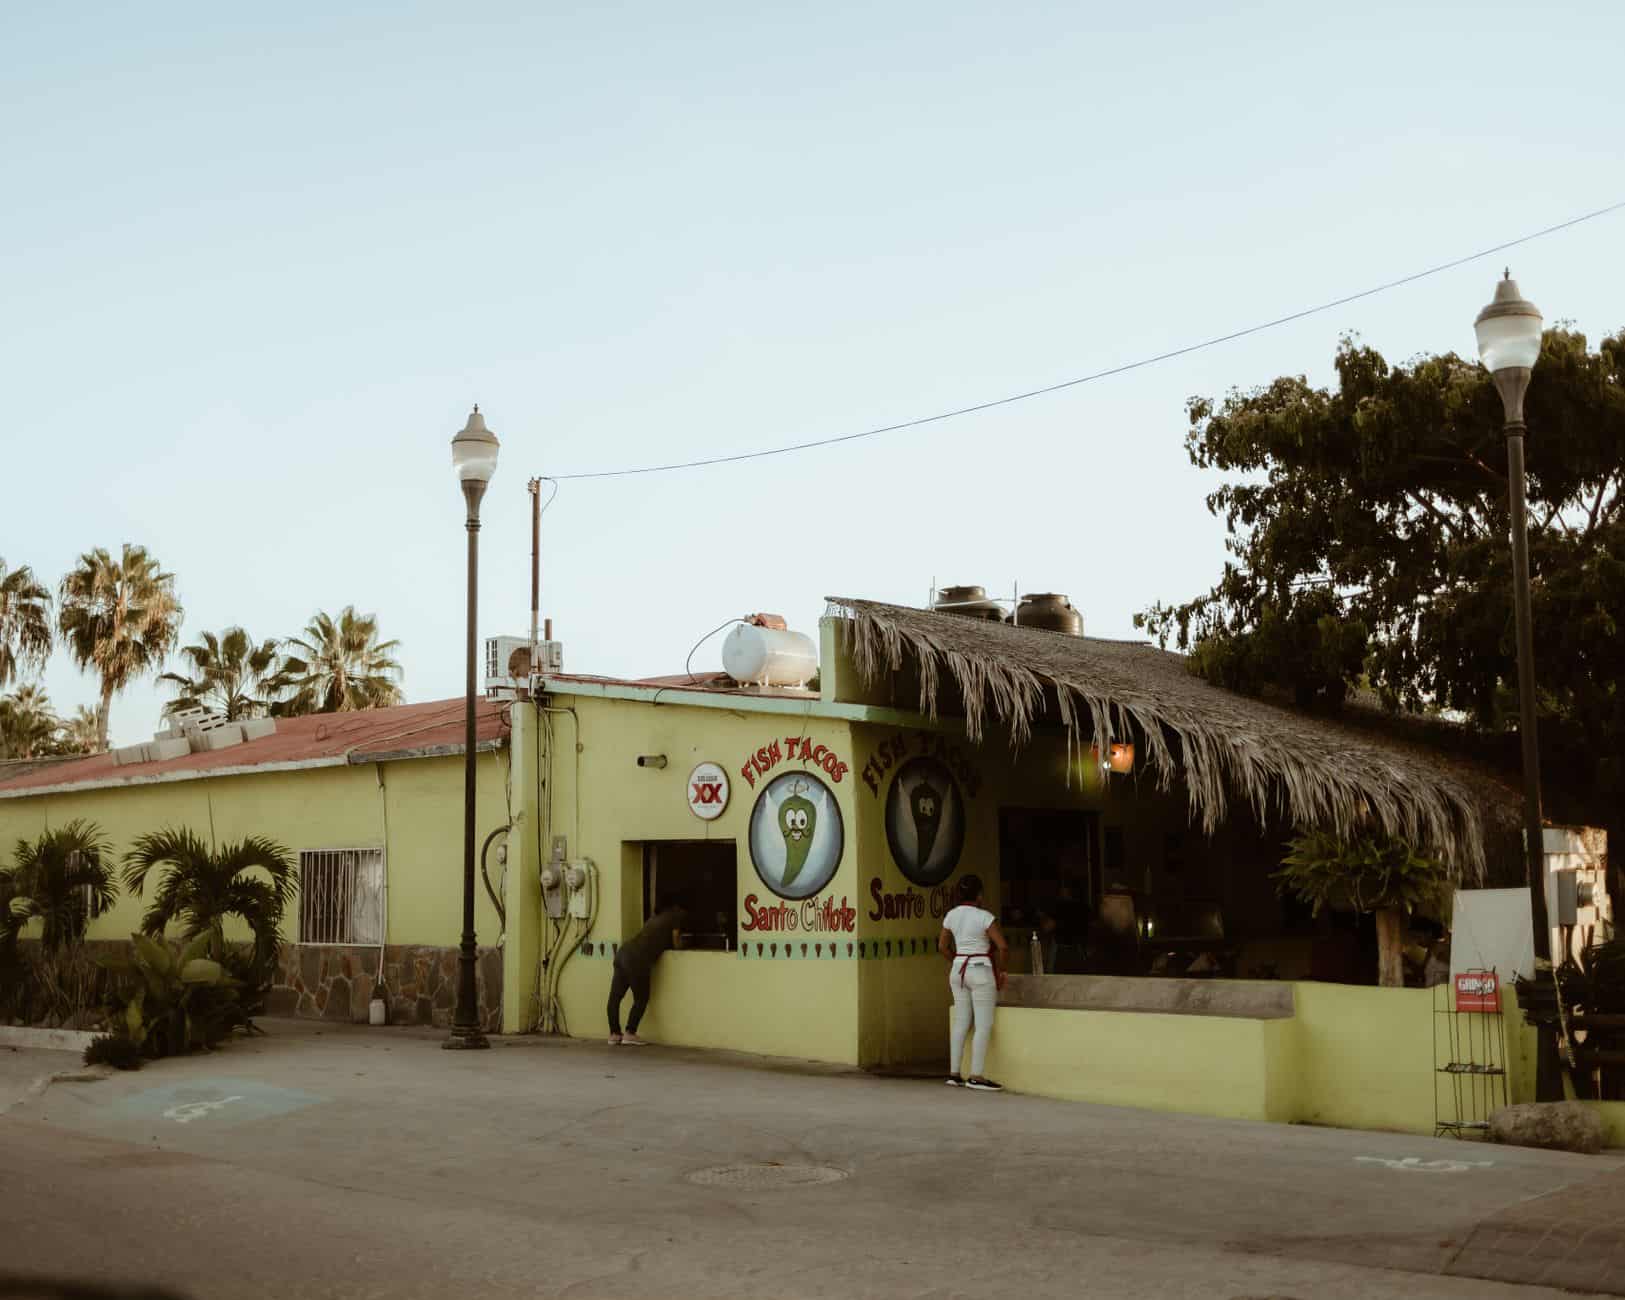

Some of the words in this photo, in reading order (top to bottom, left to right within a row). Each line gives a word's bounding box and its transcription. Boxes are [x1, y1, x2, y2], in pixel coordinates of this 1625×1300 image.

[741, 738, 783, 790] FISH
[784, 735, 848, 783] TACOS
[862, 731, 906, 799] FISH
[691, 783, 723, 804] XX
[741, 894, 798, 931] Santo
[801, 896, 856, 932] Chilote
[869, 877, 925, 921] Santo
